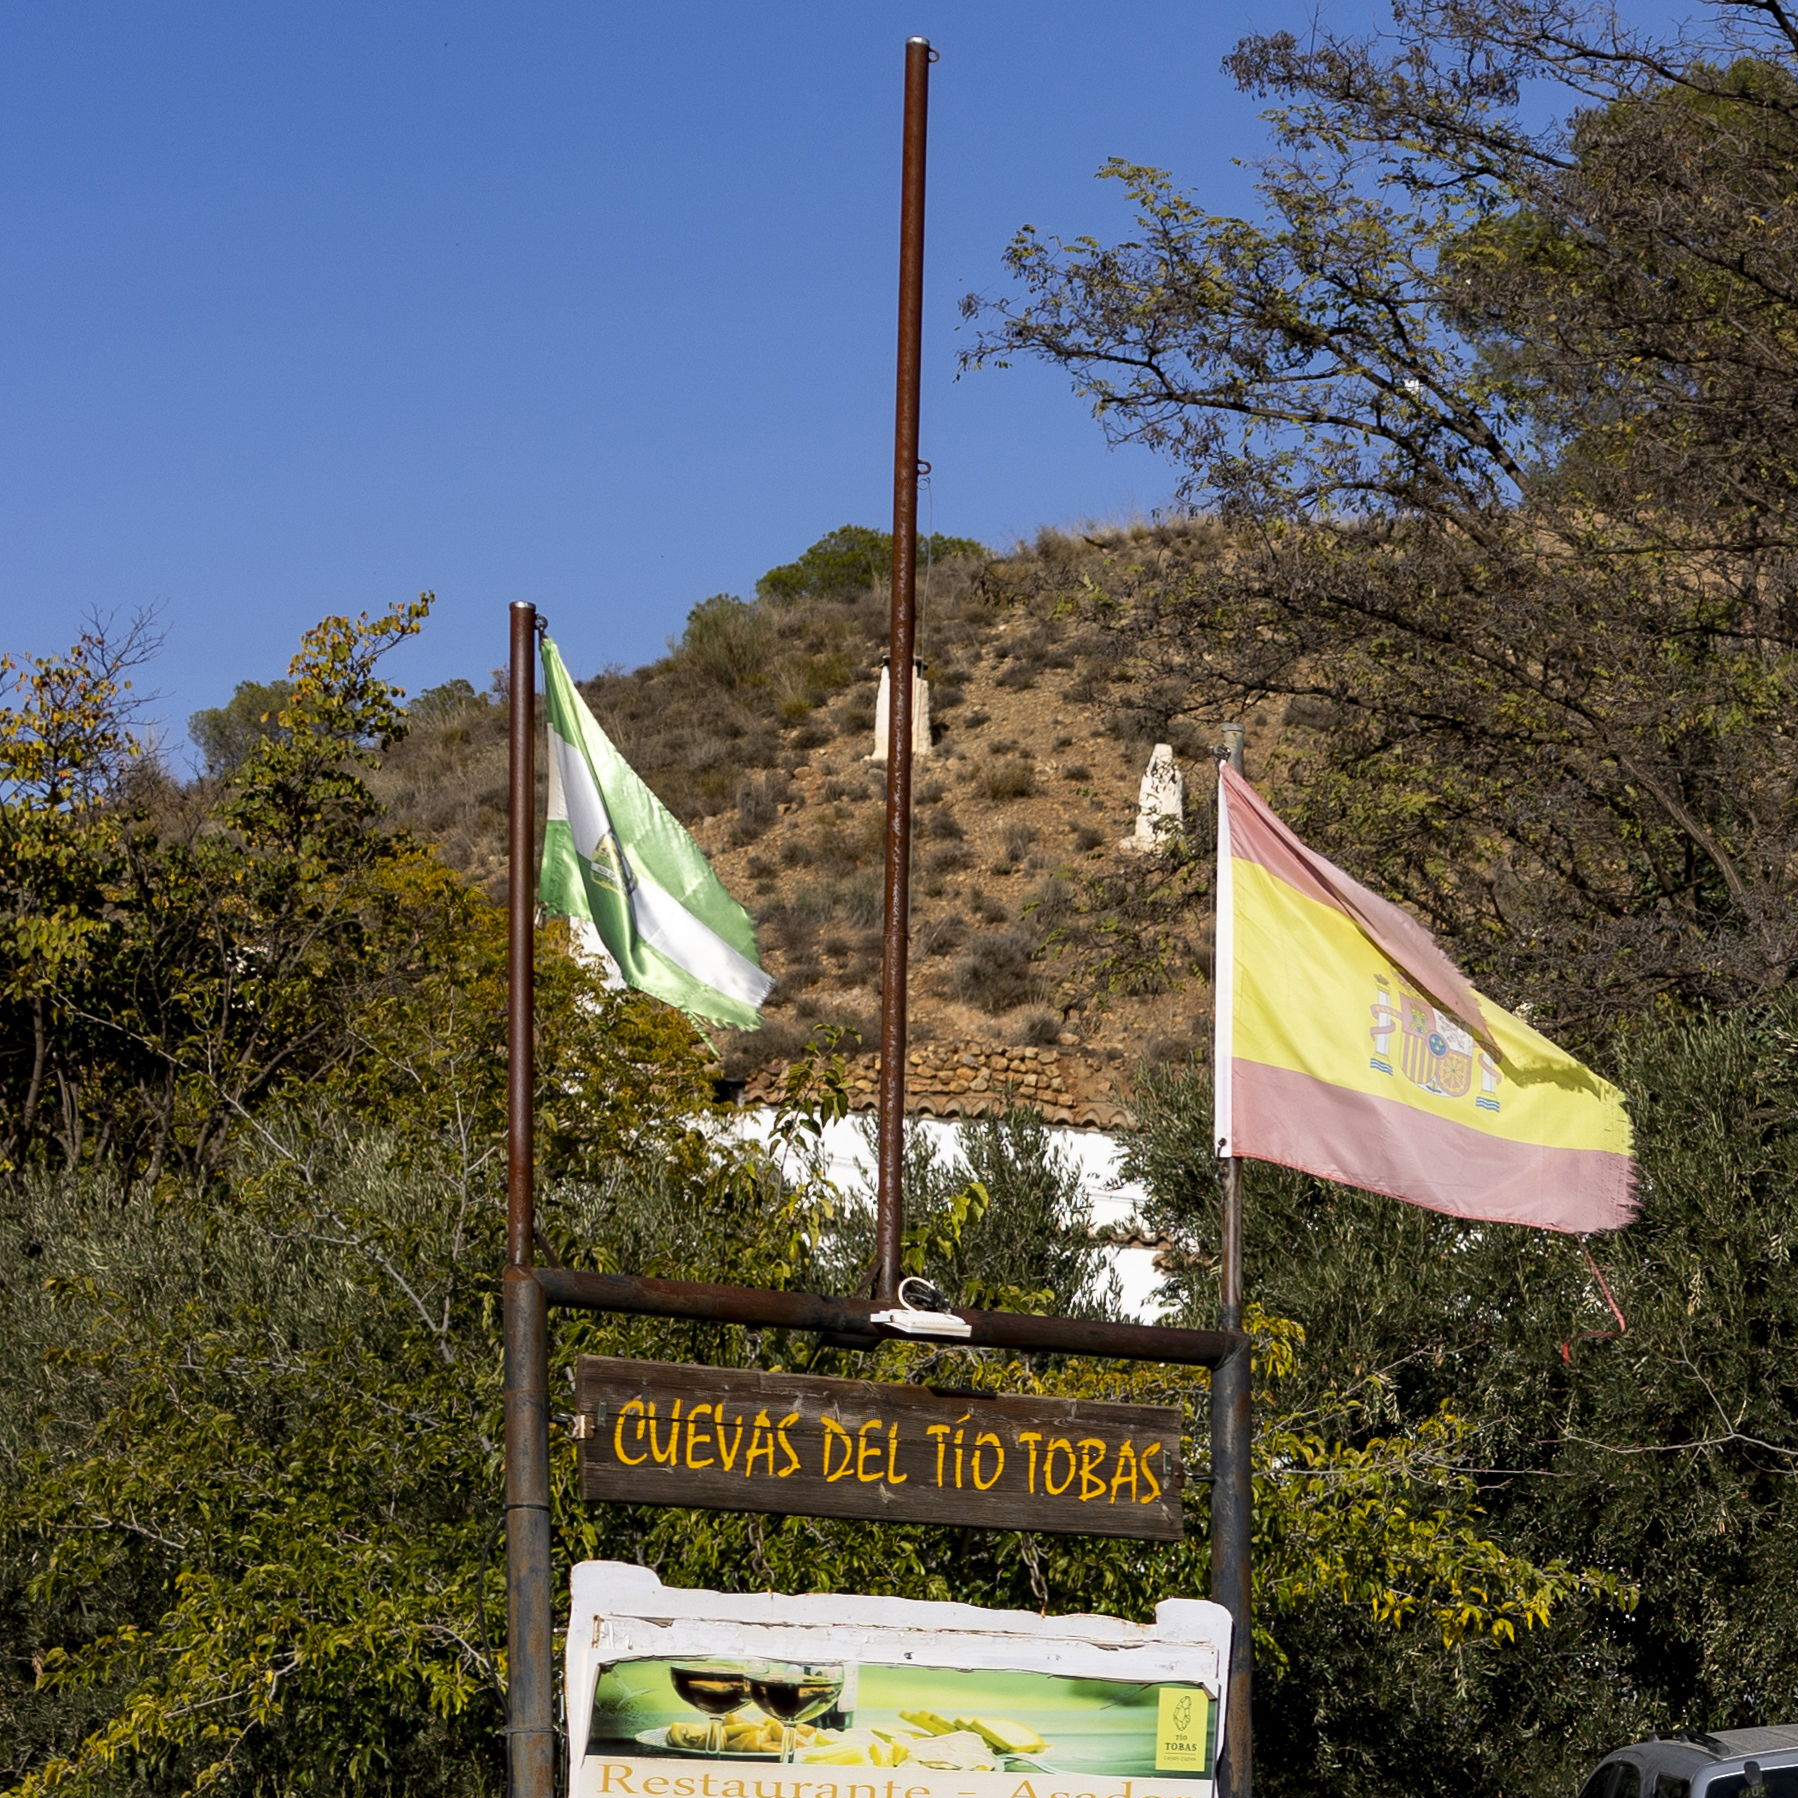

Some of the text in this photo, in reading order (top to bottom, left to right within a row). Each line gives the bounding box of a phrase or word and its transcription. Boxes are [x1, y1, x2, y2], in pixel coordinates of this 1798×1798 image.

[614, 1399, 1162, 1504] CUEVAS DEL TÍO TOBAS
[1165, 1742, 1197, 1752] TOBAS
